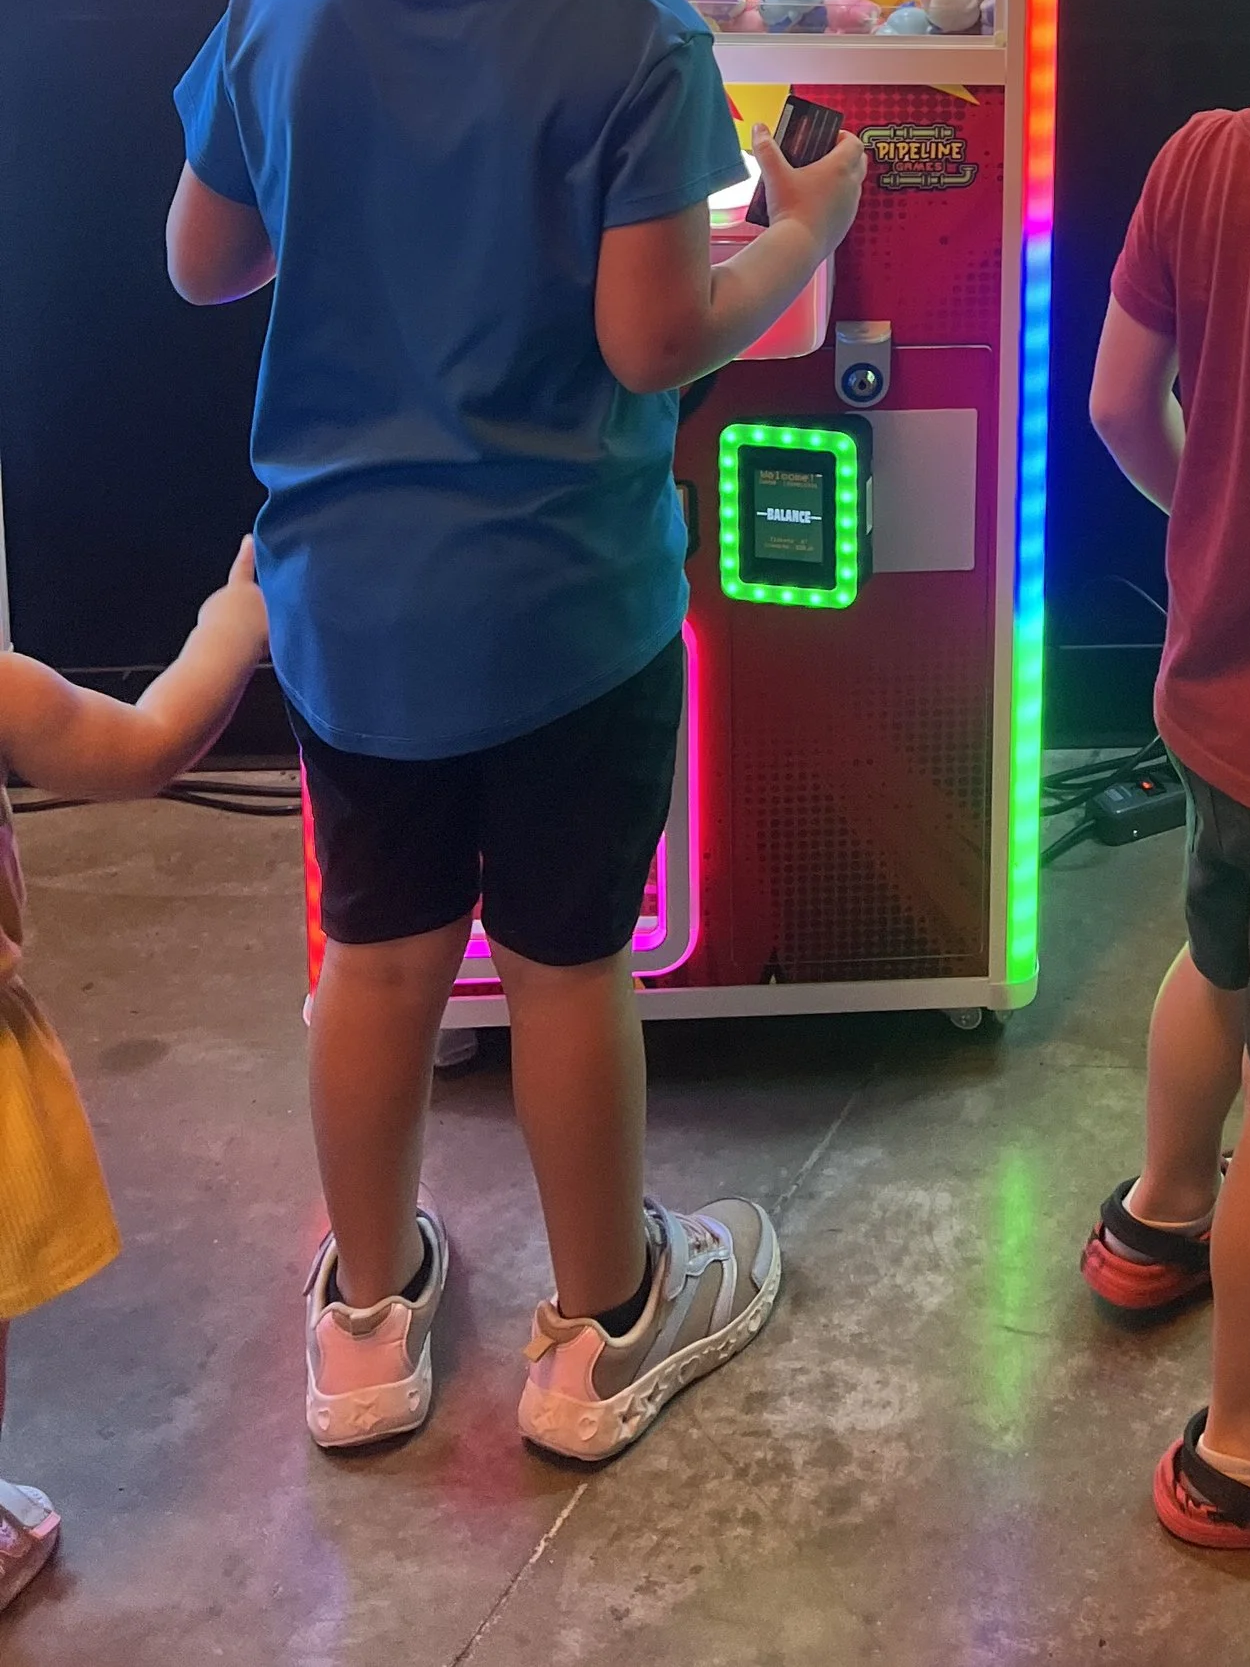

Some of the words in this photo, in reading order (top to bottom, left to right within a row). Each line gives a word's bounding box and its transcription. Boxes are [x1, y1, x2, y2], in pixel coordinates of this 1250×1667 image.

[876, 142, 963, 160] PIPELINE
[895, 161, 943, 172] GAMES
[766, 507, 811, 524] BALANCE
